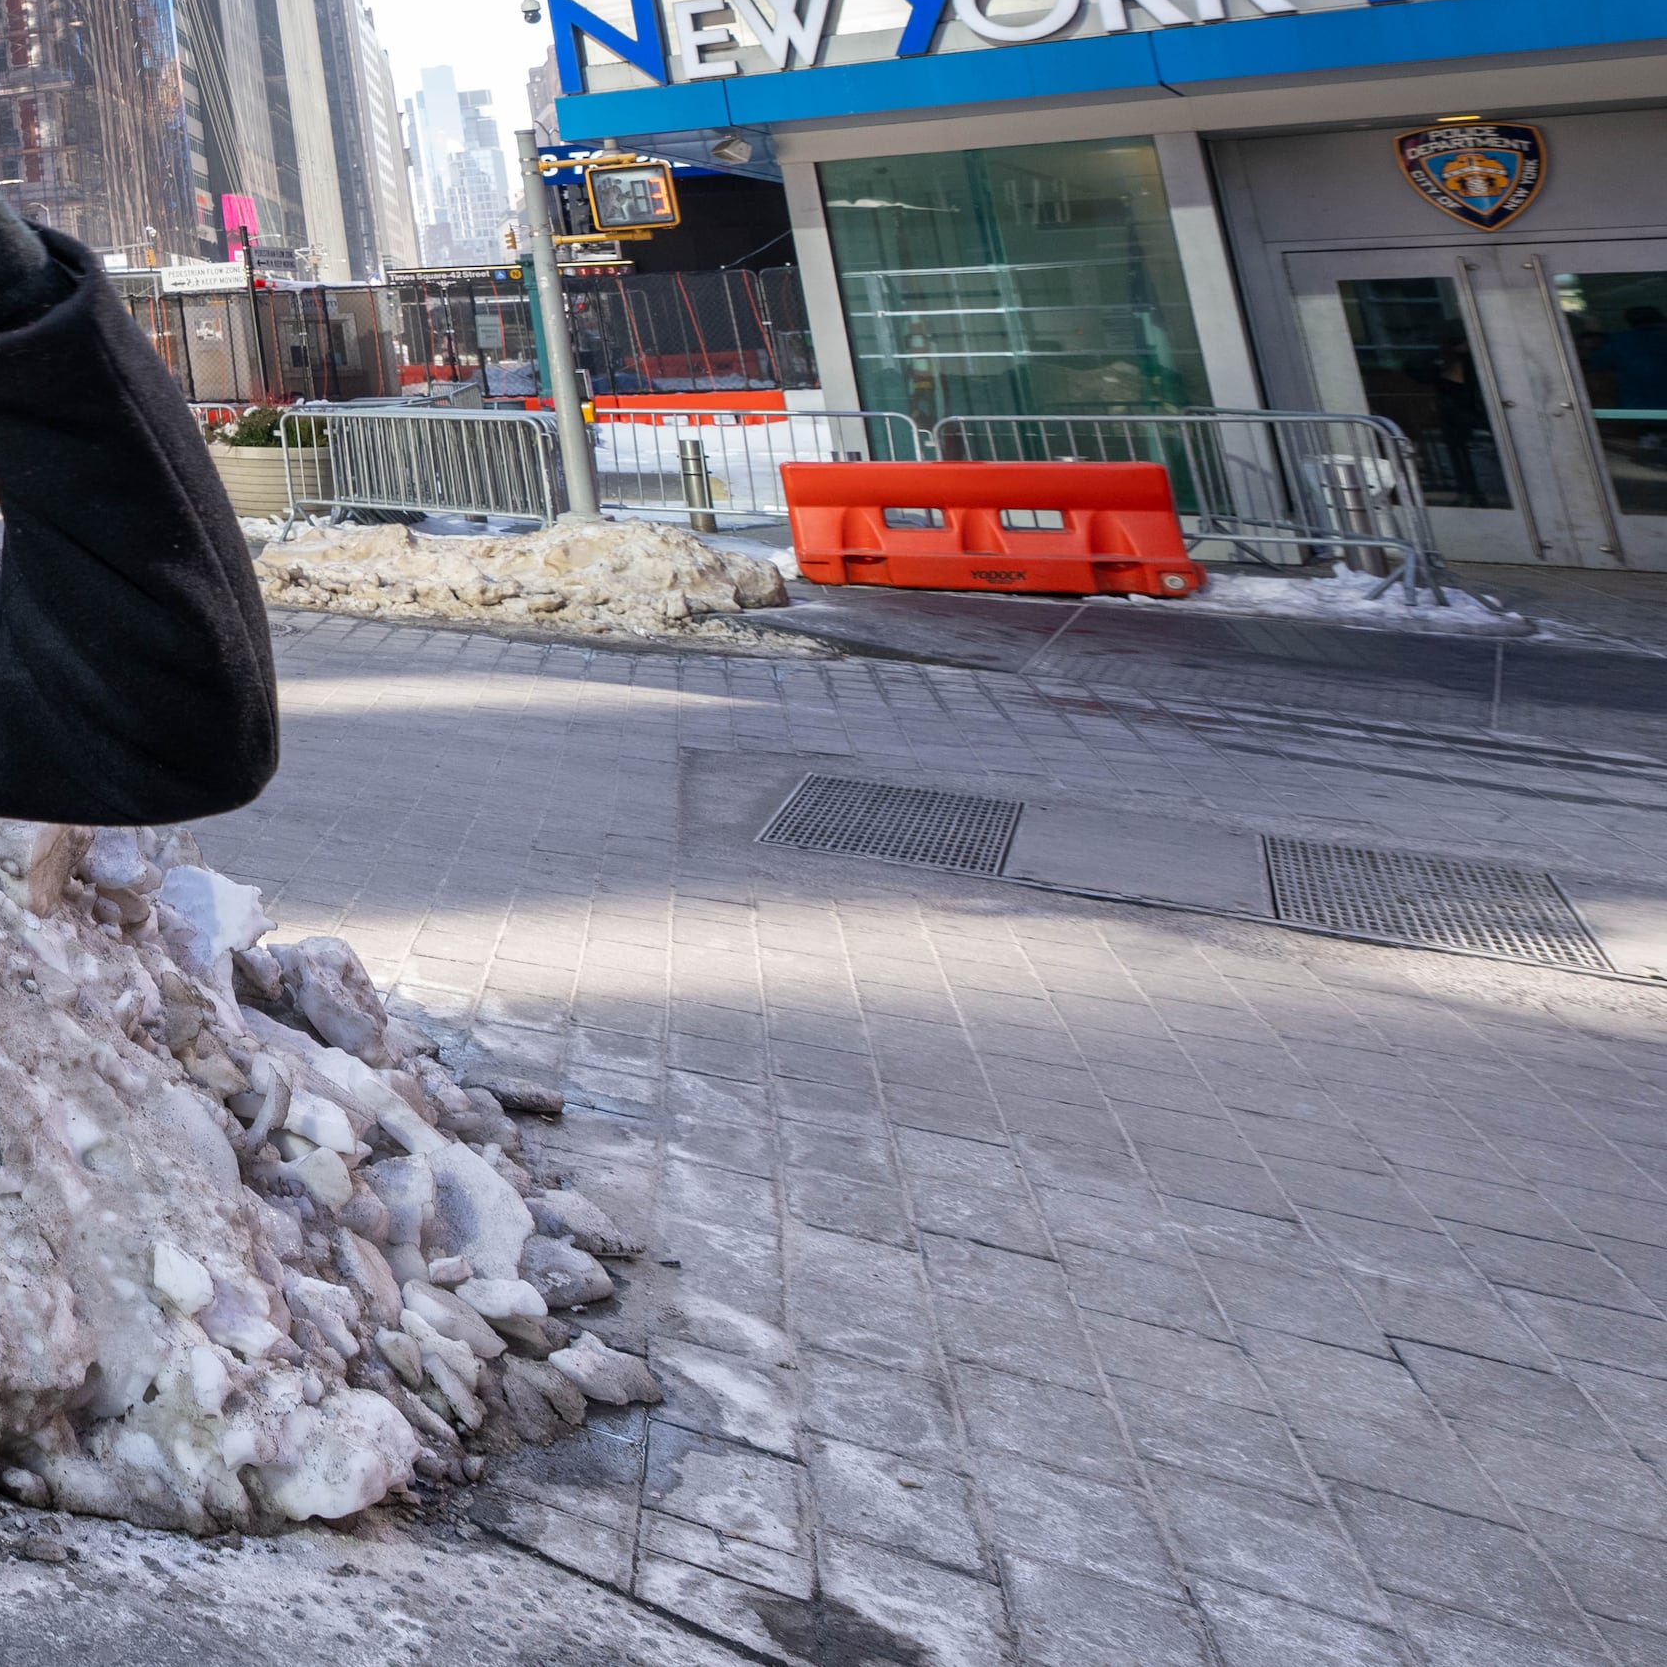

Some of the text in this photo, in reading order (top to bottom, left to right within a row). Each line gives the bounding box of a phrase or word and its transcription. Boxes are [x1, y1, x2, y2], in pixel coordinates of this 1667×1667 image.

[1428, 126, 1500, 141] POLICE
[1405, 137, 1532, 160] DEPARTMENT
[1411, 170, 1441, 195] CITY
[1436, 196, 1463, 209] OF
[1502, 159, 1539, 211] NEW YORK
[168, 266, 242, 277] PEDESTRIAN FLOW ZONE
[390, 273, 415, 281] Times
[219, 276, 244, 284] MOVING
